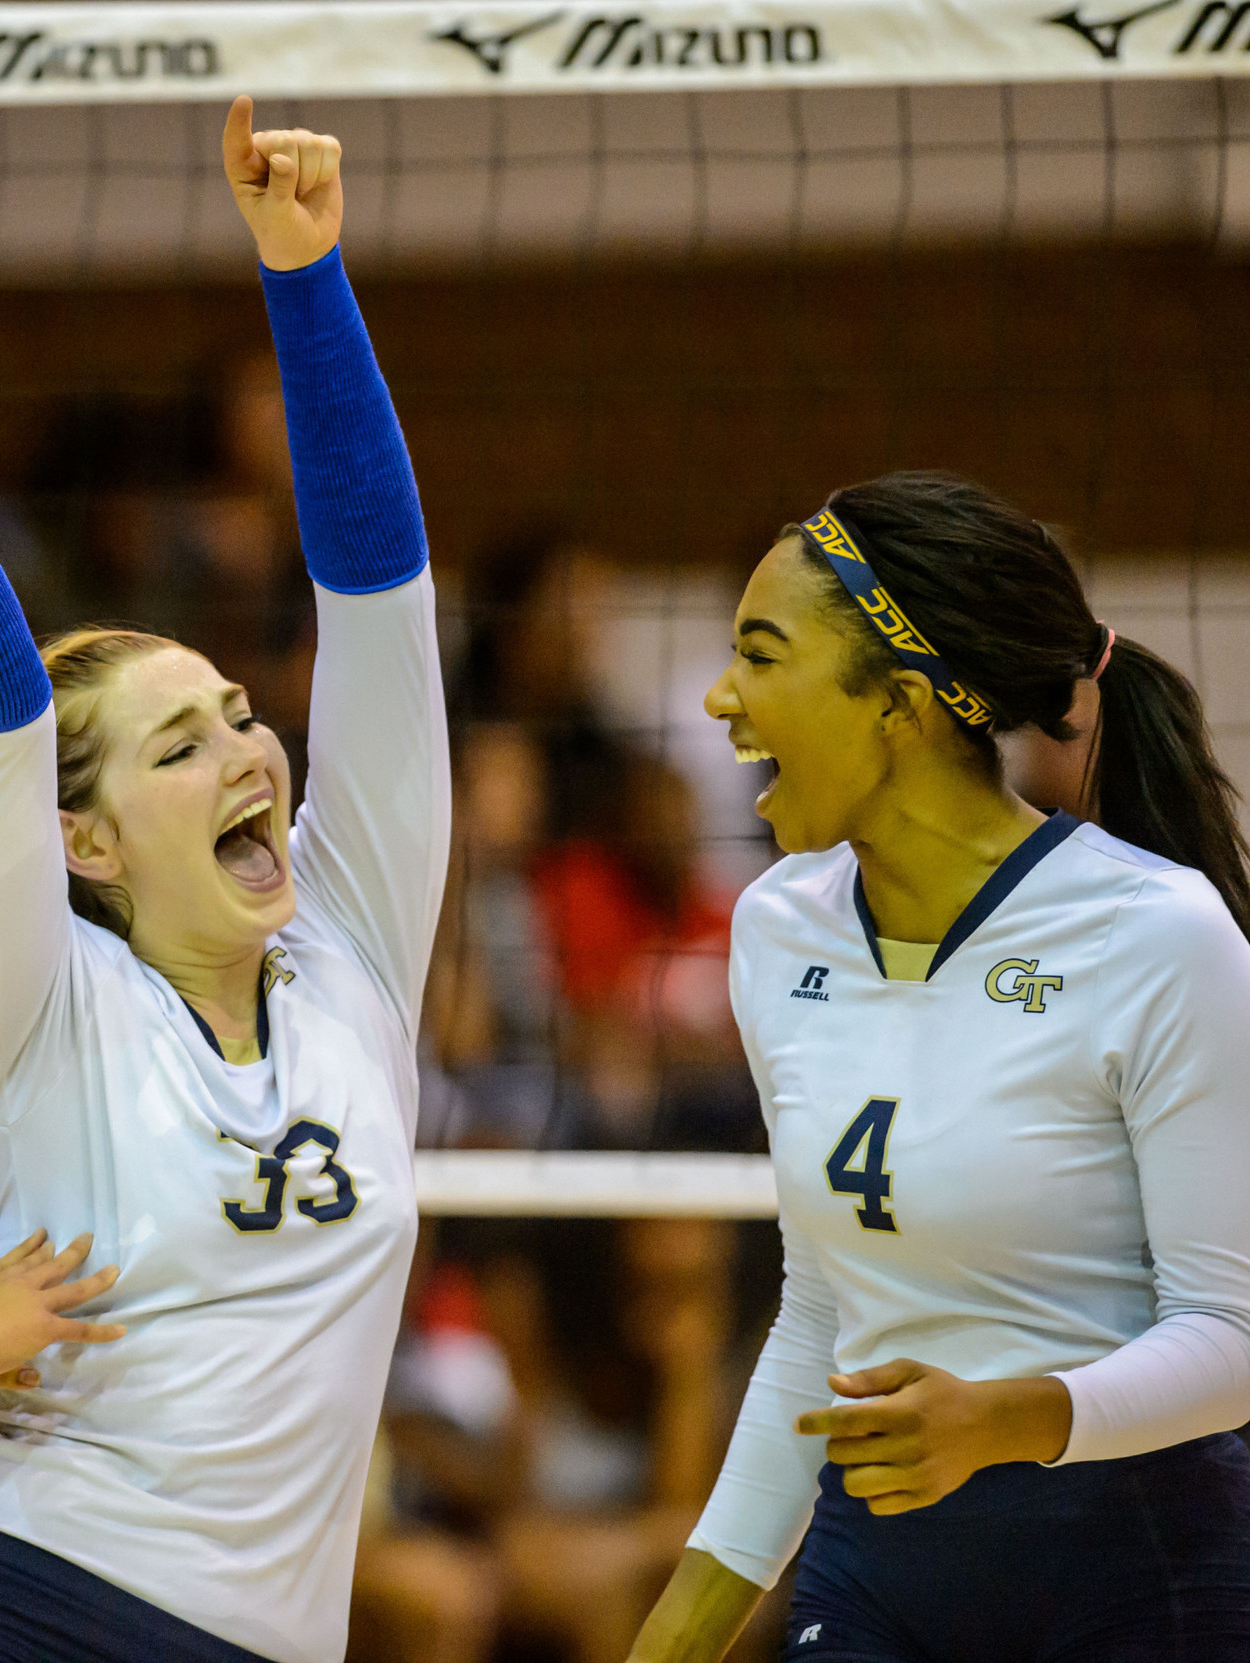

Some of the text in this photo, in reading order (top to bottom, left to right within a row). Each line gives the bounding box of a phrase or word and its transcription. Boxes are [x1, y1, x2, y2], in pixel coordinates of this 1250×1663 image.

[804, 512, 860, 562] ACC
[855, 588, 932, 656] ACC
[936, 681, 993, 726] ACC
[790, 989, 830, 1002] RUSSELL
[985, 957, 1063, 1013] GT
[823, 1095, 902, 1236] 4
